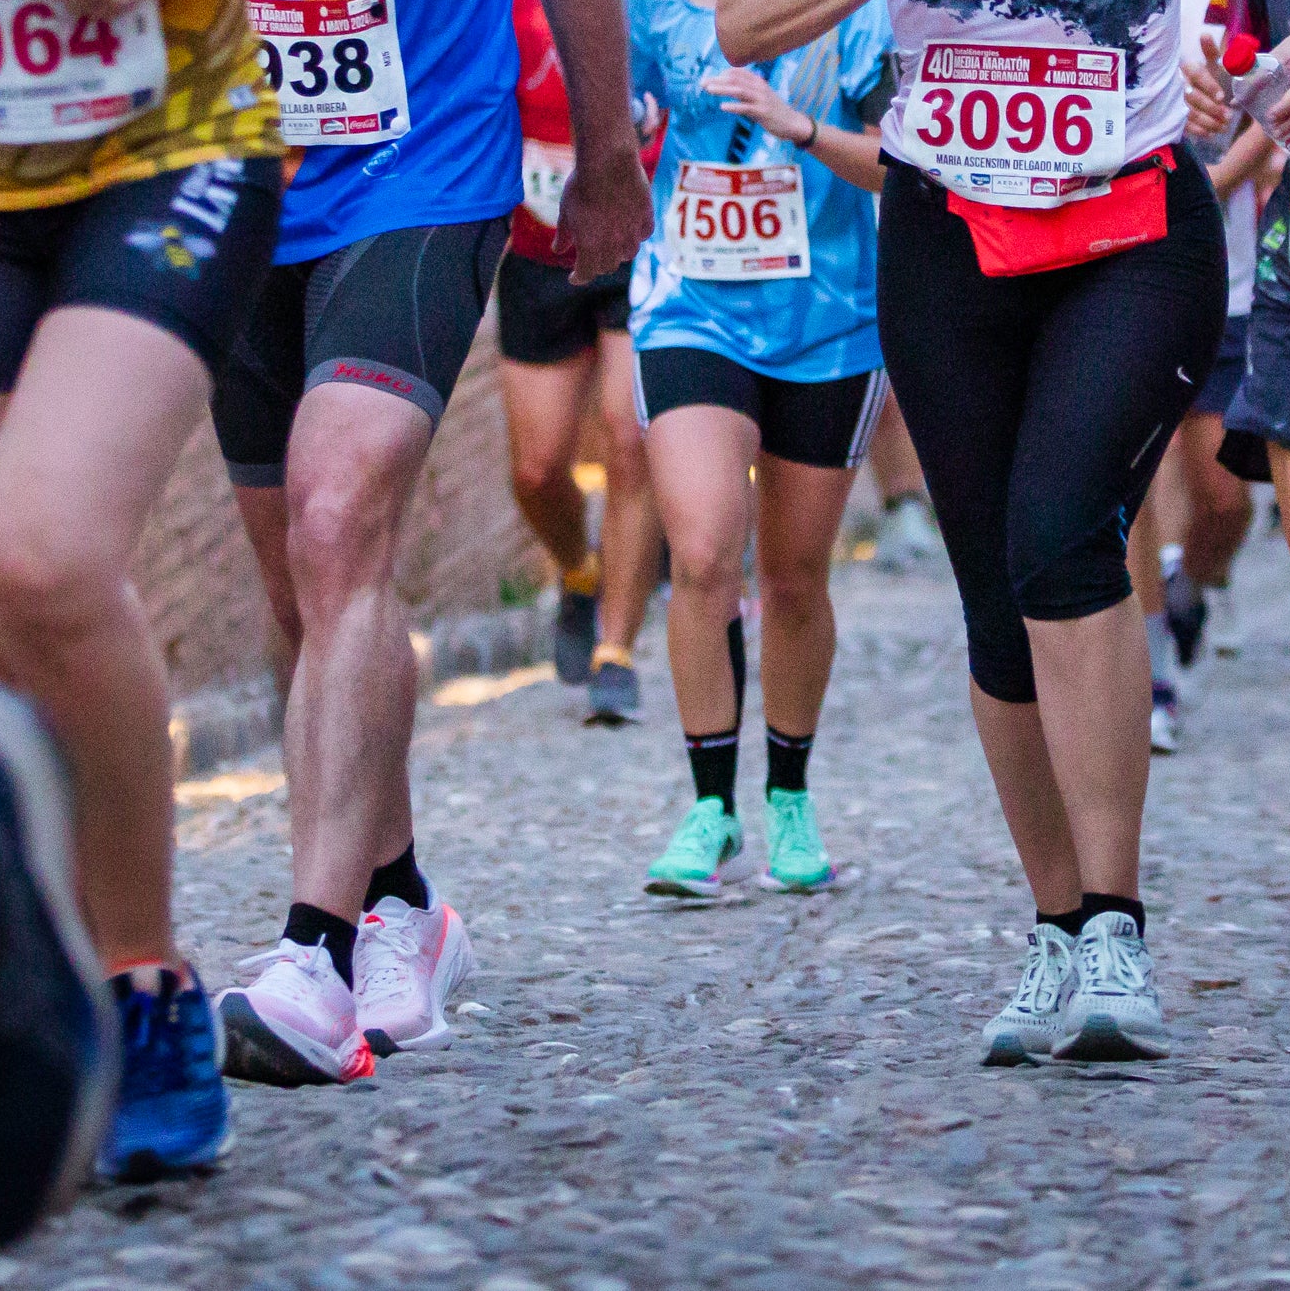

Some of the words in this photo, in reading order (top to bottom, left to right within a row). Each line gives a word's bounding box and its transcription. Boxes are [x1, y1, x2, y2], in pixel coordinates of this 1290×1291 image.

[255, 38, 374, 97] 938
[928, 47, 954, 79] 40
[954, 56, 981, 69] MEDIA
[983, 56, 1030, 71] MARATÓN
[953, 68, 978, 80] CIUDAD
[979, 70, 989, 81] DE
[992, 71, 1030, 83] GRANADA
[1044, 70, 1051, 84] 4
[1053, 71, 1076, 85] MAYO
[1078, 72, 1099, 86] 2024
[317, 102, 347, 113] RIBERA
[916, 88, 1094, 156] 3096
[1106, 119, 1115, 136] M50
[936, 153, 962, 166] MARIA
[964, 155, 1010, 169] ASCENSION
[1012, 158, 1052, 172] DELGADO
[1054, 162, 1083, 173] MOLES
[676, 196, 783, 242] 1506
